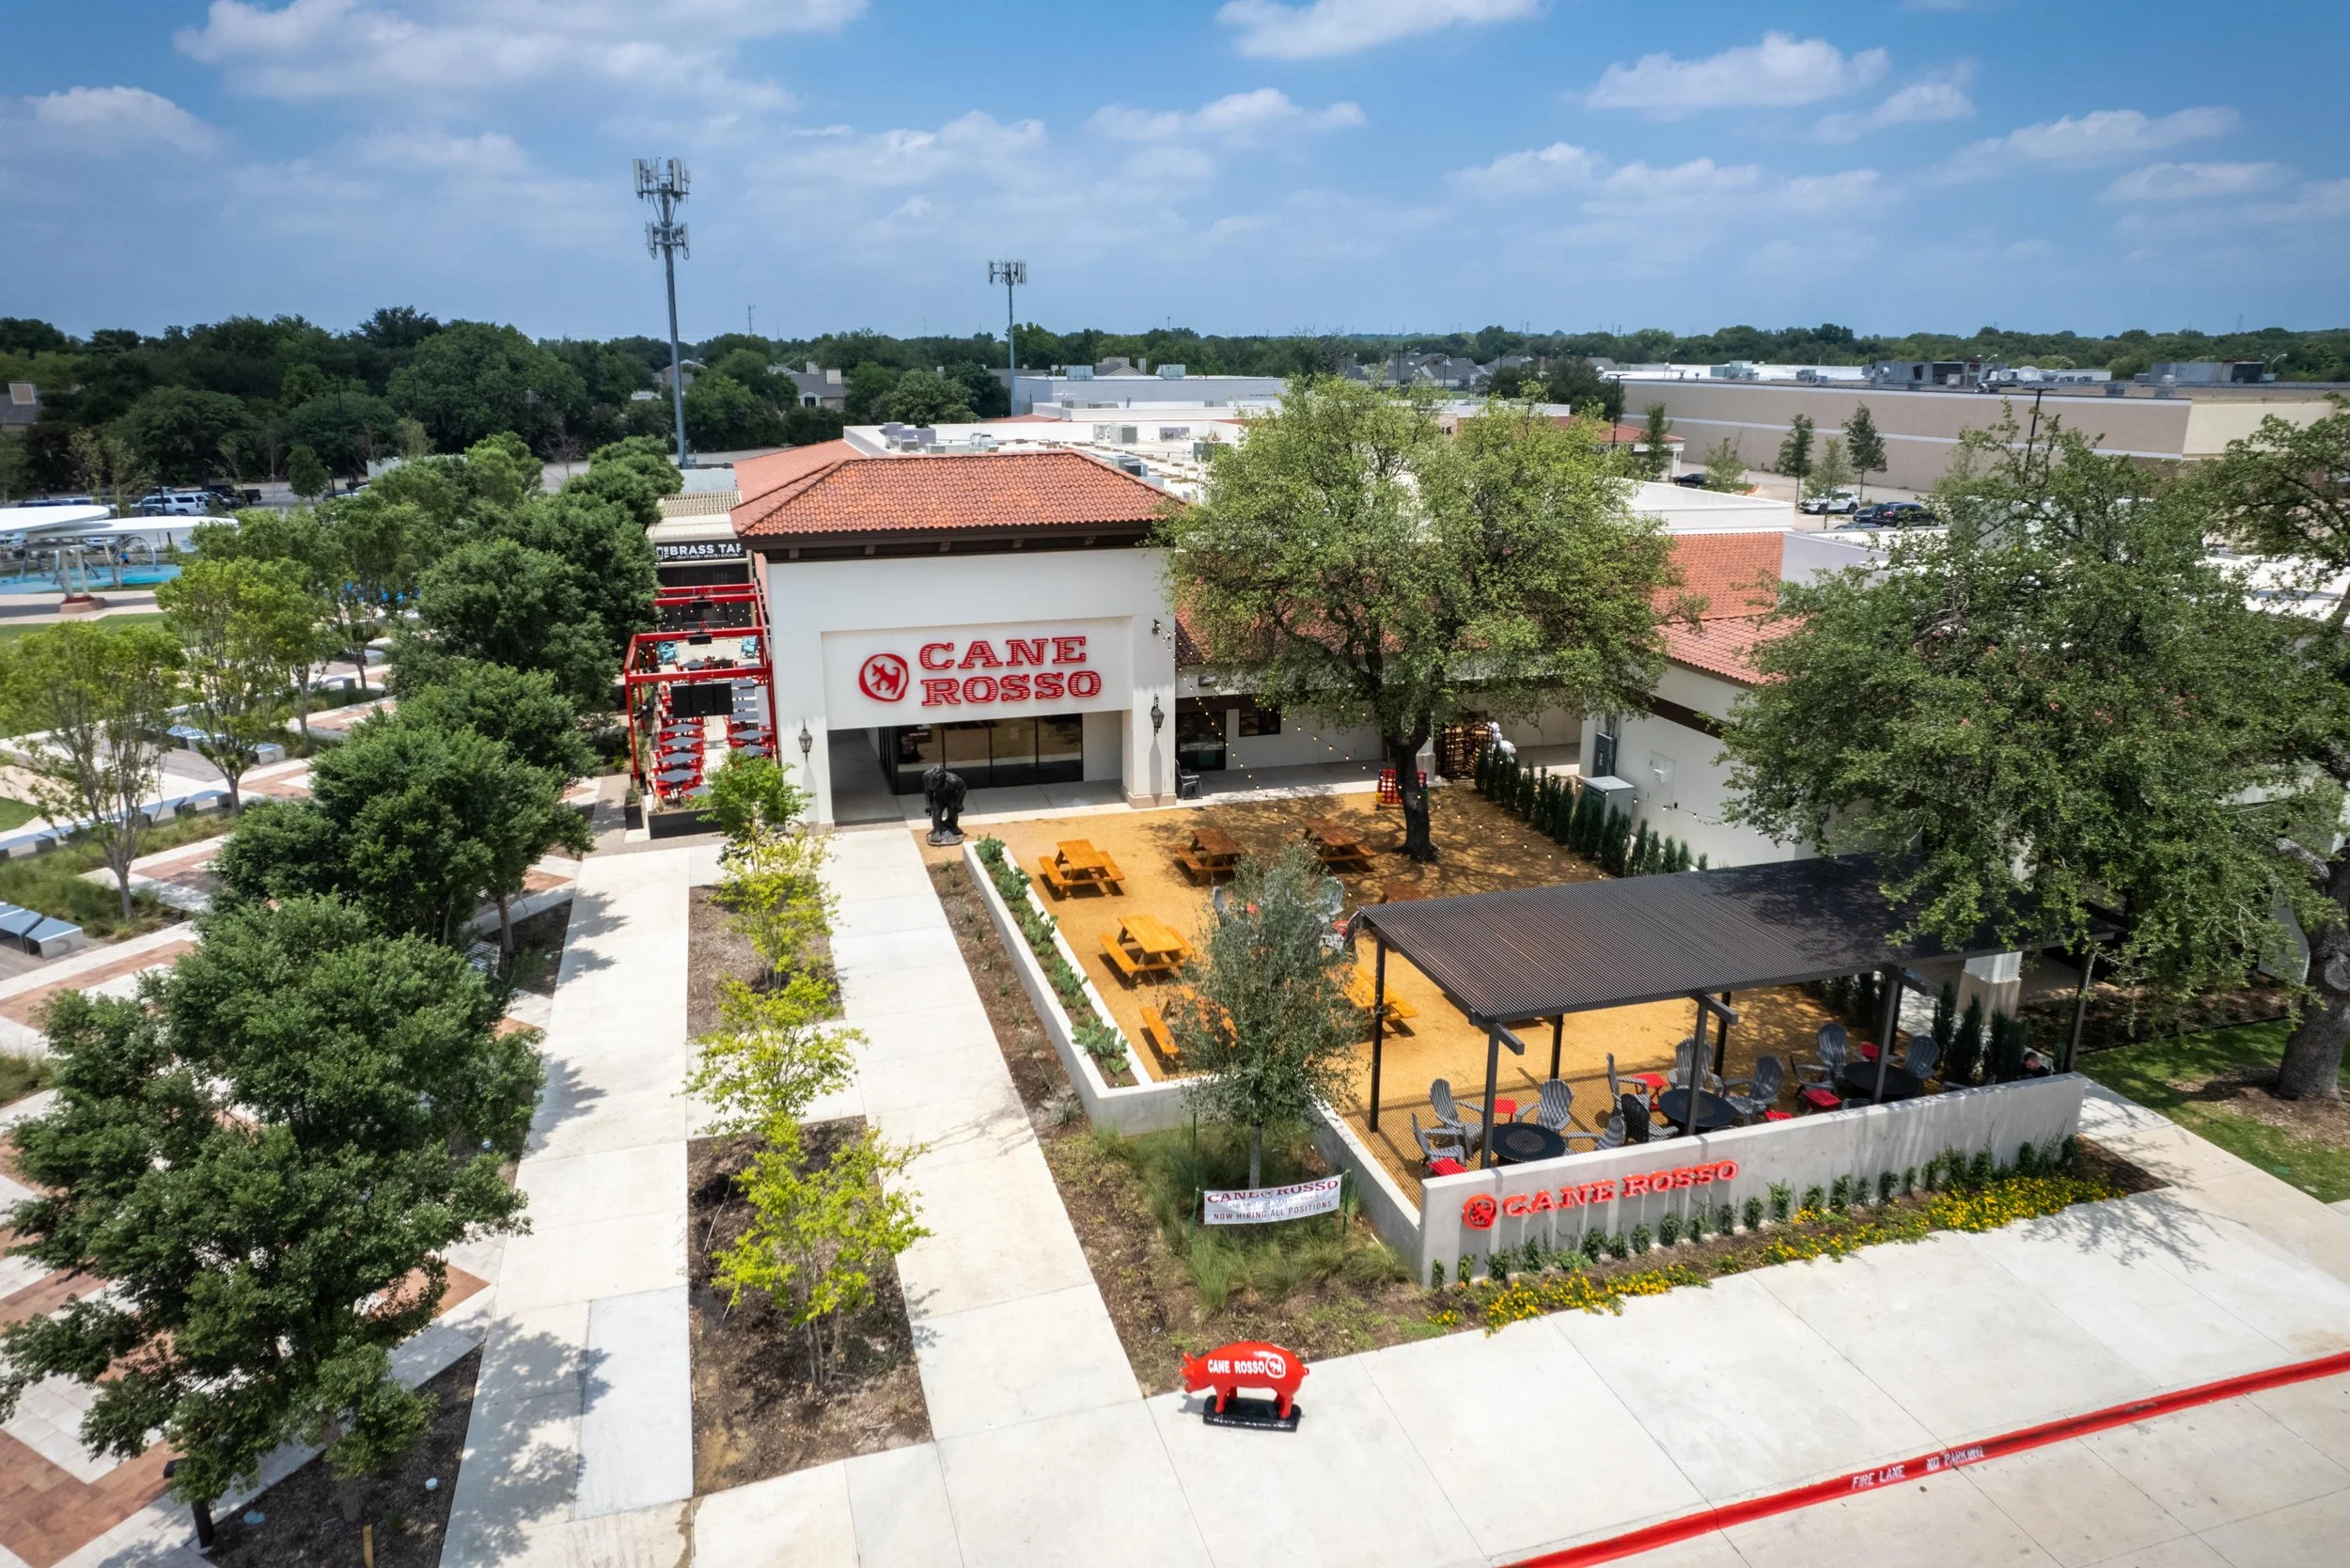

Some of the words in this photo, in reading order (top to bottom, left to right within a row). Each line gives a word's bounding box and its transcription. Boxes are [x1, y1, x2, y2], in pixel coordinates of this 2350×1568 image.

[669, 544, 714, 556] BRASS
[918, 635, 1087, 670] CANE
[920, 670, 1102, 706] ROSSO
[1207, 1190, 1260, 1203] CANE
[1276, 1180, 1339, 1196] ROSSO
[1503, 1179, 1616, 1217] CANE
[1622, 1159, 1739, 1198] ROSSO
[1214, 1212, 1233, 1220] NOW
[1236, 1210, 1267, 1220] HIRING
[1270, 1208, 1285, 1217] ALL
[1288, 1200, 1332, 1215] POSITIONS
[1207, 1359, 1230, 1373] CANE
[1234, 1360, 1265, 1374] ROSSO
[1927, 1456, 1940, 1471] NO
[1944, 1445, 1984, 1466] PARKING
[1852, 1472, 1874, 1489] FIRE
[1880, 1465, 1906, 1482] LANE
